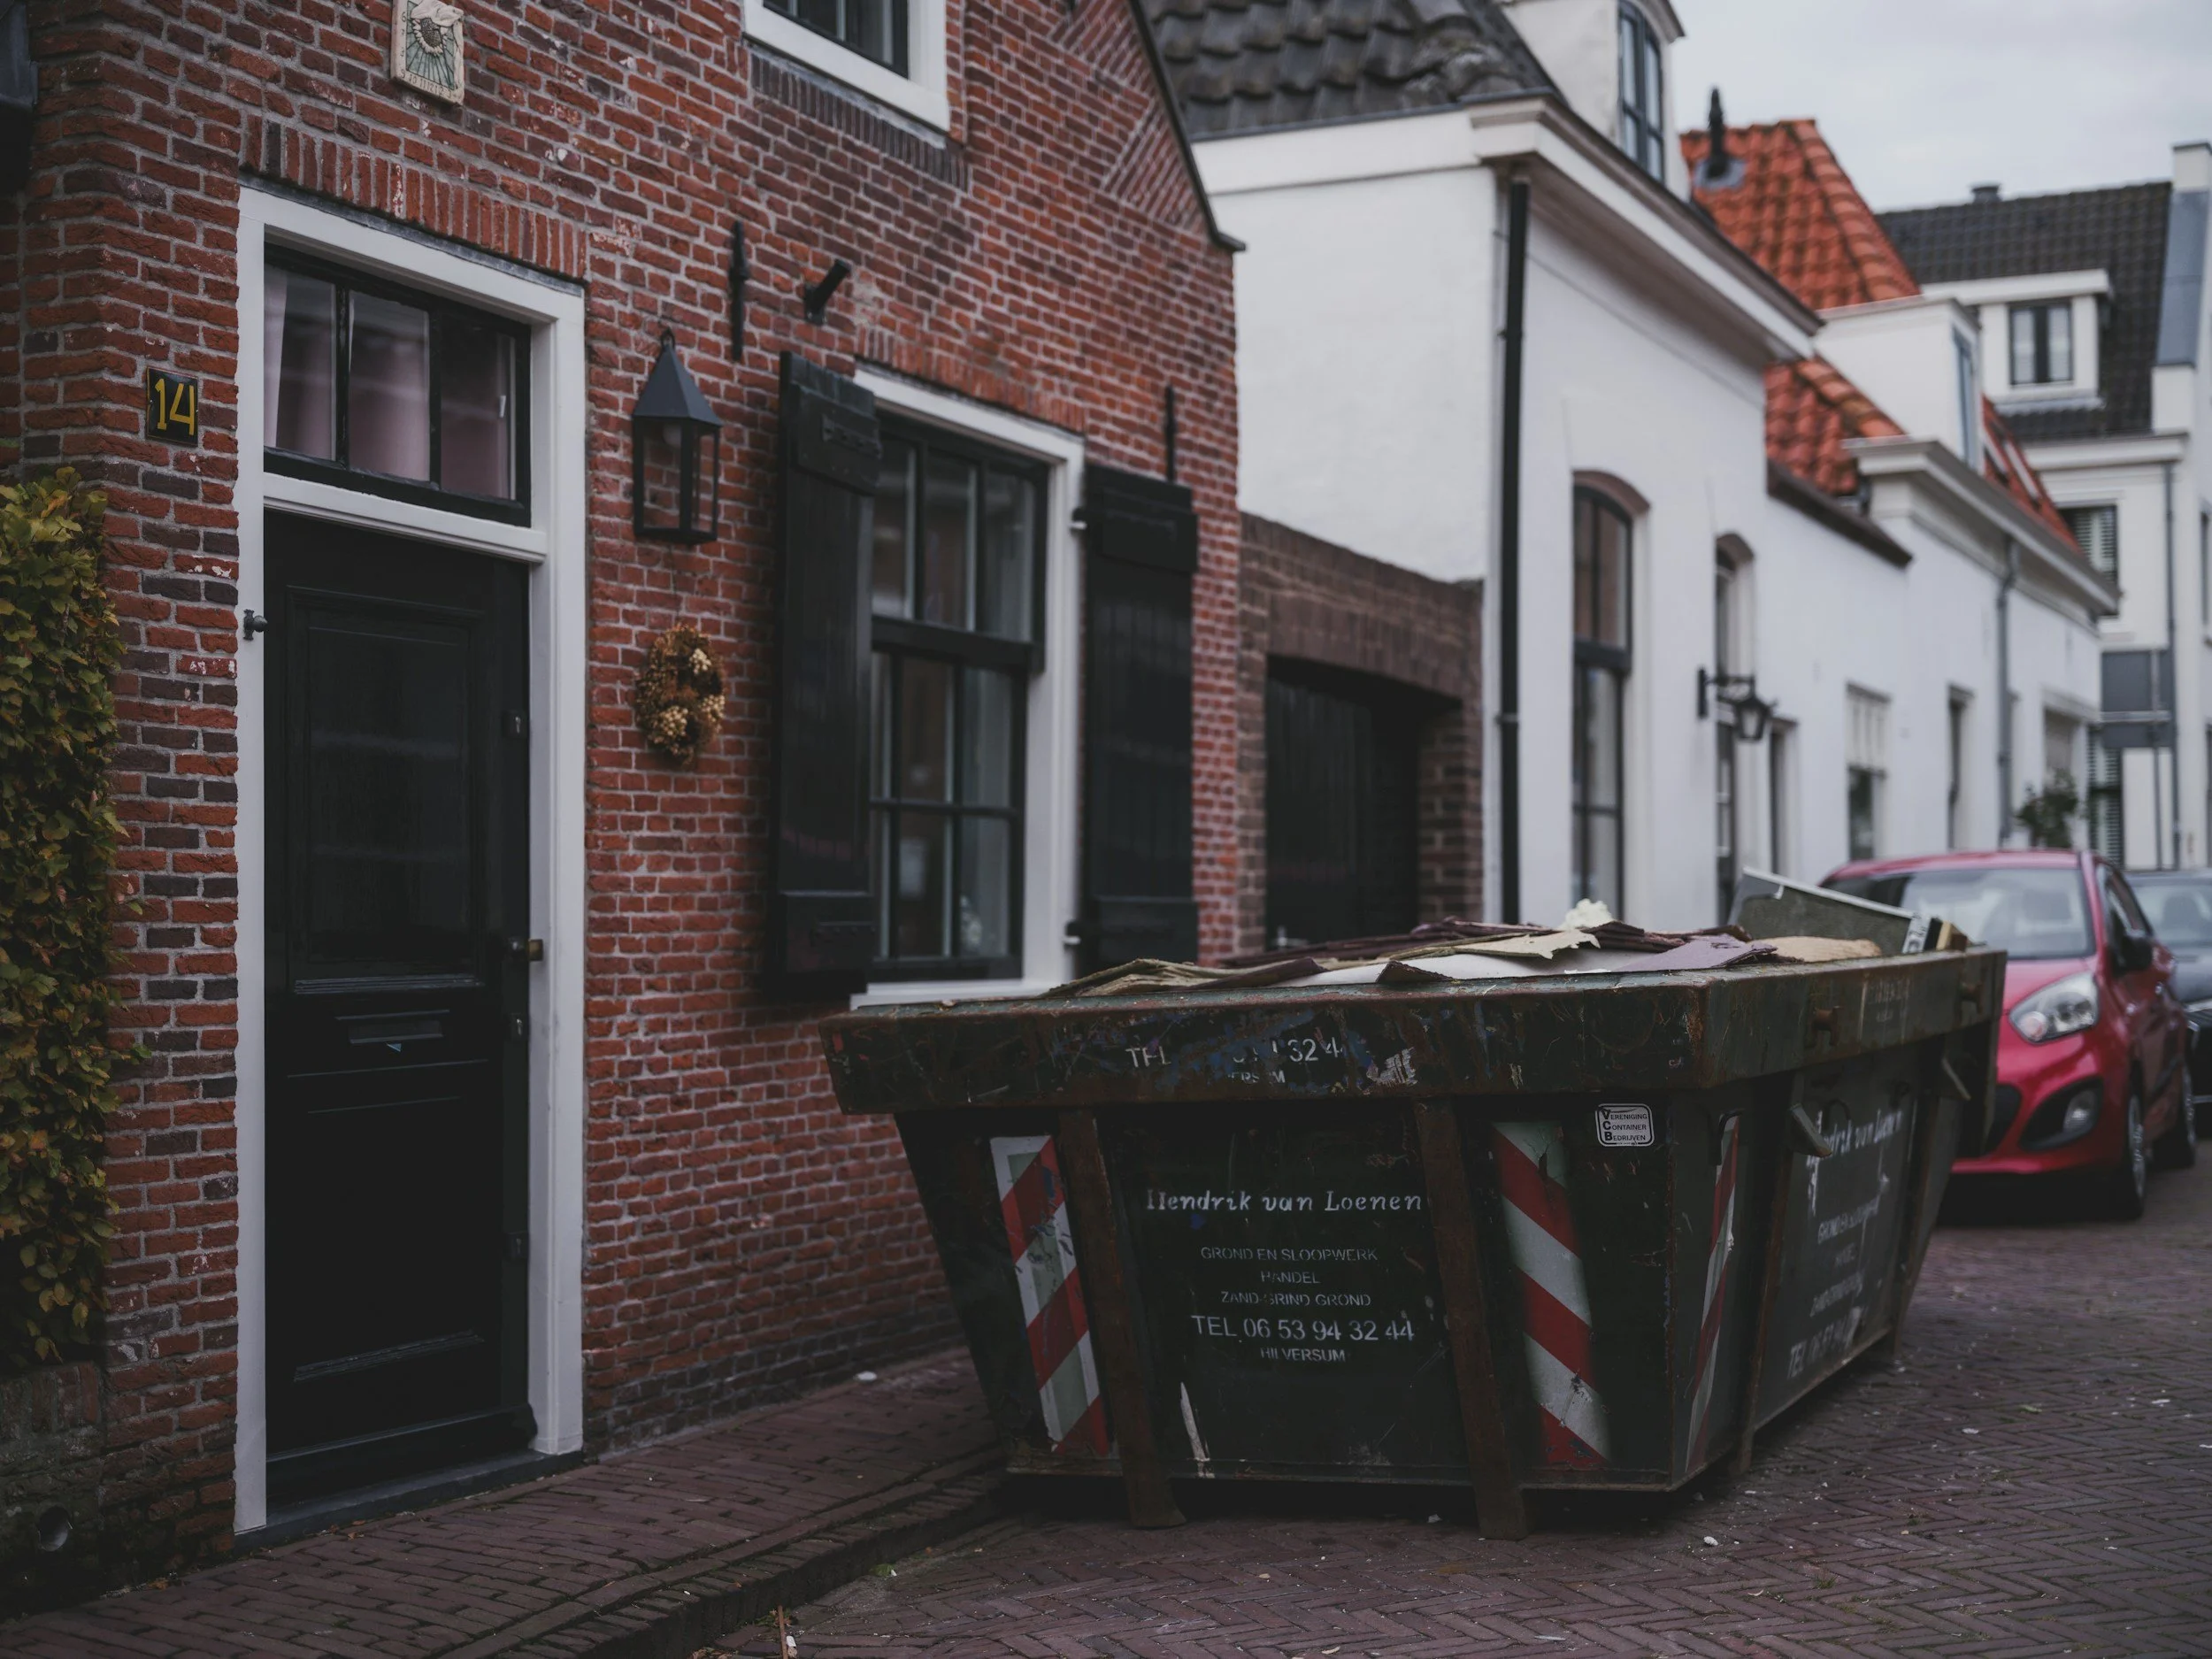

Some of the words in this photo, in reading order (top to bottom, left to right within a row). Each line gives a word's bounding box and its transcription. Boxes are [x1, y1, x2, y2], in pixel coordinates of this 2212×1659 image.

[155, 378, 195, 436] 14
[1286, 1038, 1318, 1062] 32
[1601, 1109, 1647, 1120] VERENIGING
[1602, 1120, 1647, 1131] CONTAINER
[1604, 1132, 1646, 1141] BEDRIJVEN
[1146, 1189, 1252, 1211] Hendrik
[1261, 1194, 1314, 1211] van
[1324, 1190, 1422, 1211] Loenen
[1201, 1247, 1253, 1261] GROND
[1257, 1248, 1278, 1261] EN
[1281, 1248, 1378, 1262] SLOOPWERK
[1260, 1270, 1321, 1284] HANDEL
[1315, 1294, 1371, 1307] GROND
[1190, 1315, 1238, 1337] TEL
[1243, 1317, 1271, 1339] 06
[1277, 1319, 1306, 1340] 53
[1312, 1320, 1341, 1341] 94
[1349, 1320, 1379, 1341] 32
[1385, 1320, 1415, 1341] 44
